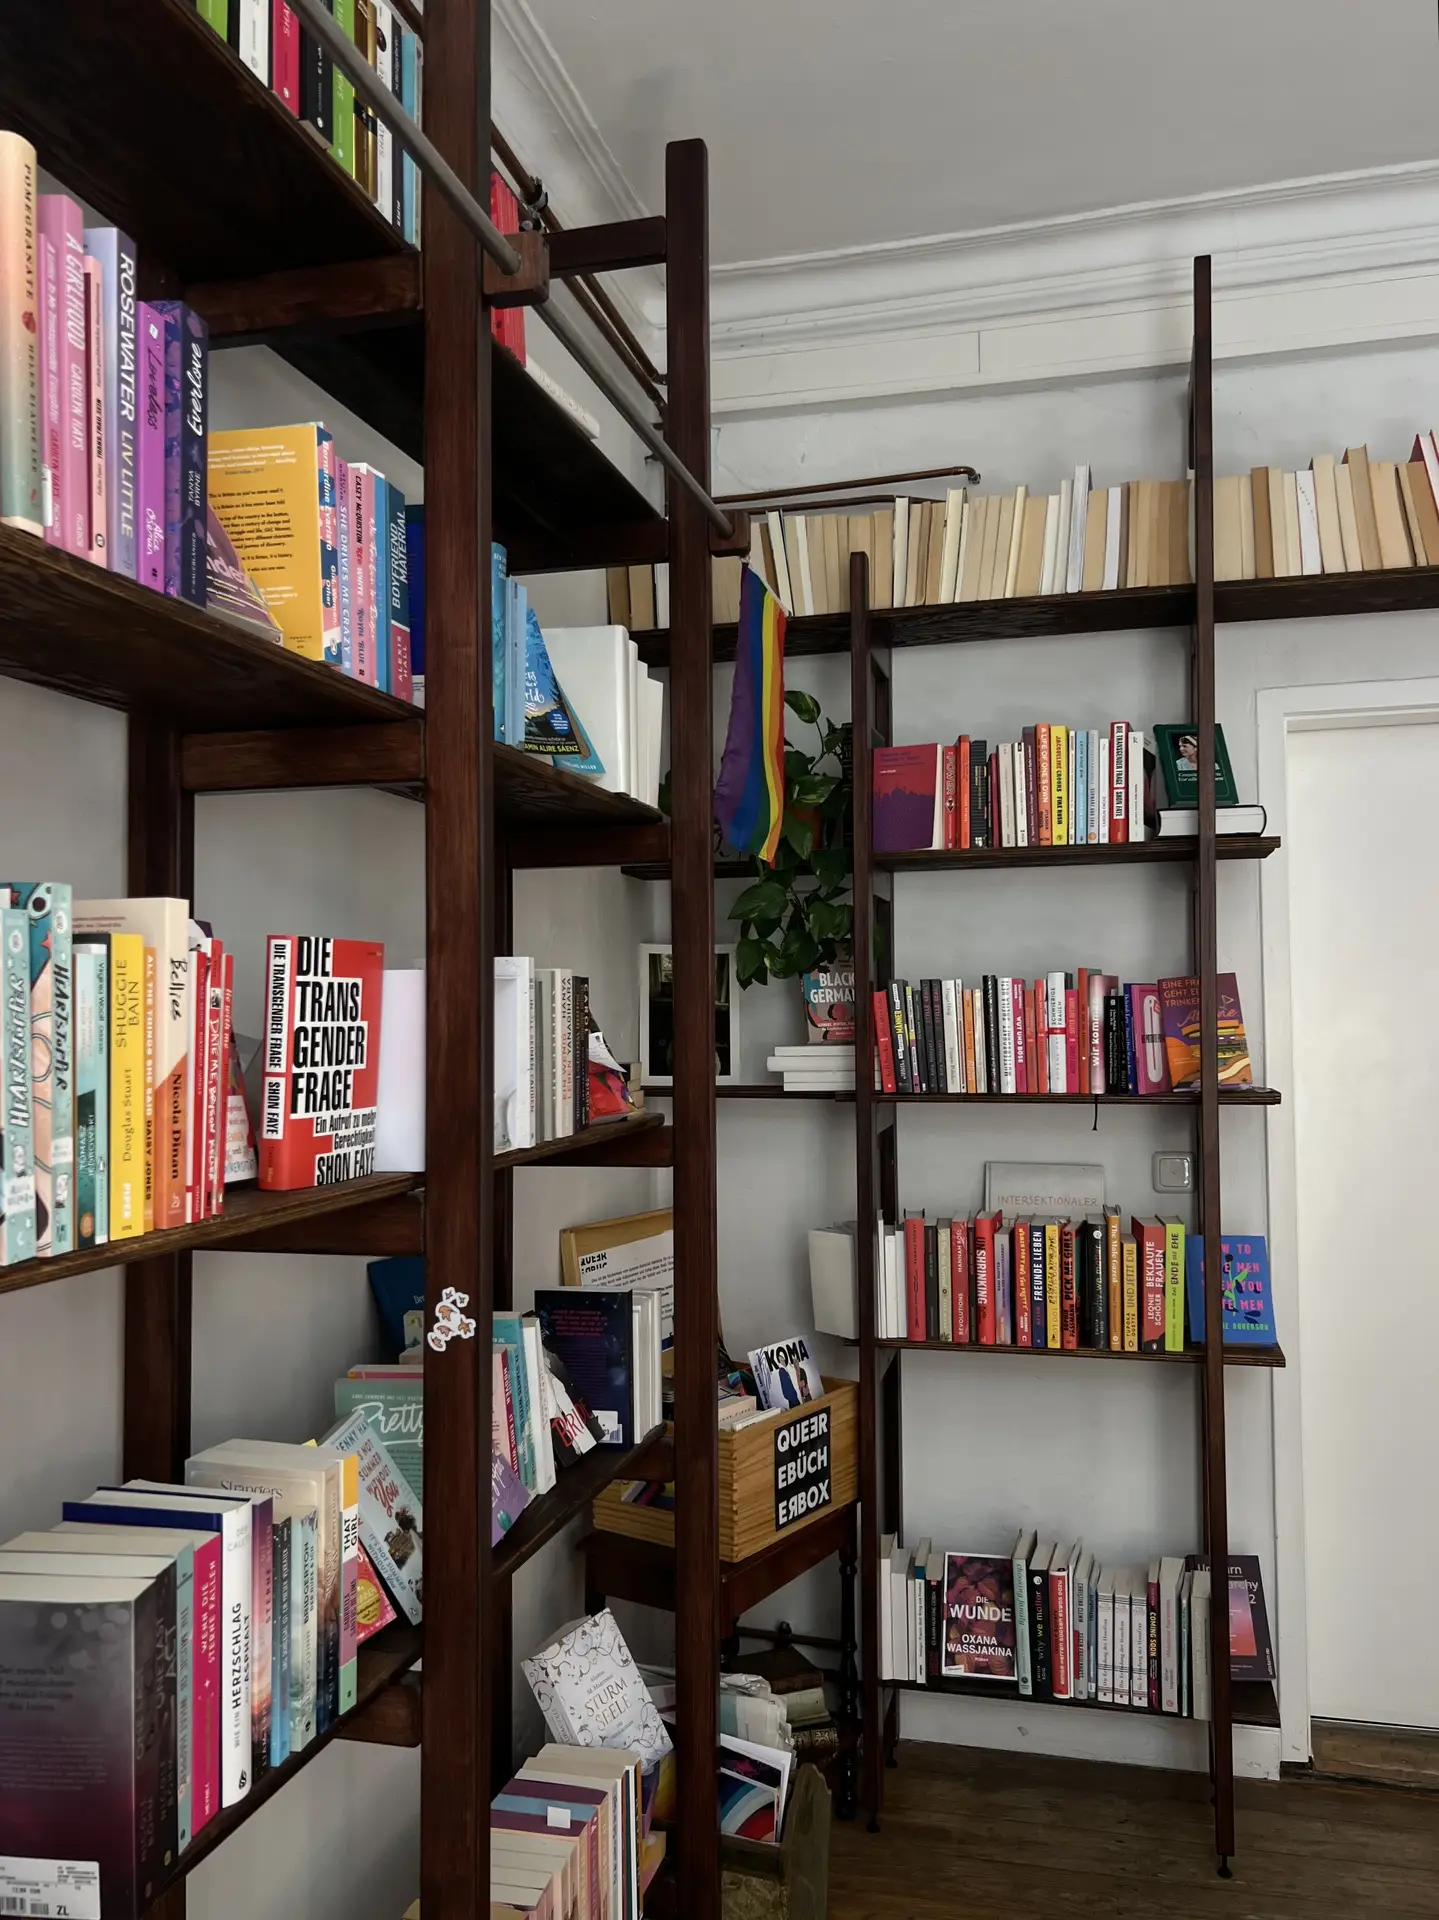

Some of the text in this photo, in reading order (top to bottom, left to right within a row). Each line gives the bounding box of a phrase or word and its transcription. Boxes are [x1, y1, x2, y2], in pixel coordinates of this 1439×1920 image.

[25, 164, 33, 300] POMEGRANATE
[66, 233, 85, 351] A GIRLHOOD
[120, 252, 134, 421] ROSEWATER
[70, 363, 84, 451] CAROLYN HAYS
[147, 348, 163, 430] Loveless
[186, 342, 203, 436] Everlove
[51, 428, 60, 499] CAROLYN HAYS
[121, 430, 133, 538] LIV LITTLE
[322, 440, 335, 551] Bernardine Evaristo
[153, 523, 164, 551] Alice
[339, 505, 347, 532] SHE
[391, 523, 401, 609] BOYFRIEND
[397, 511, 408, 584] MATERIAL
[342, 585, 349, 605] ME
[343, 608, 351, 653] CRAZY
[1042, 751, 1047, 761] OF
[297, 936, 331, 977] DIE
[116, 959, 127, 1048] SHUGGIE
[128, 981, 140, 1026] BAIN
[169, 958, 188, 1021] Bellies
[269, 944, 287, 1069] DIE TRANSGENDER FRAGE
[296, 980, 360, 1022] TRANS
[1164, 989, 1189, 999] GEHT
[54, 964, 69, 1090] HEARTSTOPPER
[293, 1026, 366, 1068] GENDER
[8, 973, 30, 1128] HEARTSTOPPER
[266, 1082, 280, 1134] SHON FAYE
[291, 1069, 352, 1114] FRAGE
[121, 1068, 135, 1162] Douglas Stuart
[172, 1074, 182, 1179] Nicola Dinan
[315, 1110, 376, 1134] Ein Aufruf zu mehr
[316, 1151, 352, 1186] SHON
[997, 1194, 1098, 1206] INTERSEKTIONALER
[976, 1237, 987, 1304] UNSHRINKING
[1033, 1231, 1043, 1301] FREUNDE LIEBEN
[1064, 1231, 1073, 1300] PICK ME GIRLS
[1146, 1241, 1155, 1287] BEKLAUTE
[1155, 1249, 1164, 1287] FRAUEN
[1237, 1244, 1251, 1255] TO
[1237, 1262, 1259, 1273] MEN
[1126, 1264, 1135, 1286] JETZT
[1240, 1280, 1263, 1292] YOU
[1126, 1288, 1135, 1308] UND
[1153, 1293, 1162, 1326] SCHÖLER
[1240, 1300, 1264, 1310] MEN
[766, 1339, 809, 1373] KOMA
[503, 1367, 511, 1404] HOOVER
[777, 1412, 828, 1453] QUEER
[777, 1445, 828, 1490] EBÜCH
[950, 1604, 1012, 1622] WUNDE
[976, 1596, 989, 1604] DIE
[1017, 1599, 1026, 1625] family
[1250, 1594, 1256, 1604] 2
[165, 1625, 176, 1677] ACT
[208, 1614, 216, 1664] STERNE
[946, 1643, 1012, 1657] WASSJAKINA
[962, 1634, 997, 1645] OXANA
[1036, 1624, 1043, 1637] we
[232, 1602, 241, 1709] HERZSCHLAG
[584, 1677, 628, 1719] STURM
[595, 1693, 633, 1731] SEELE
